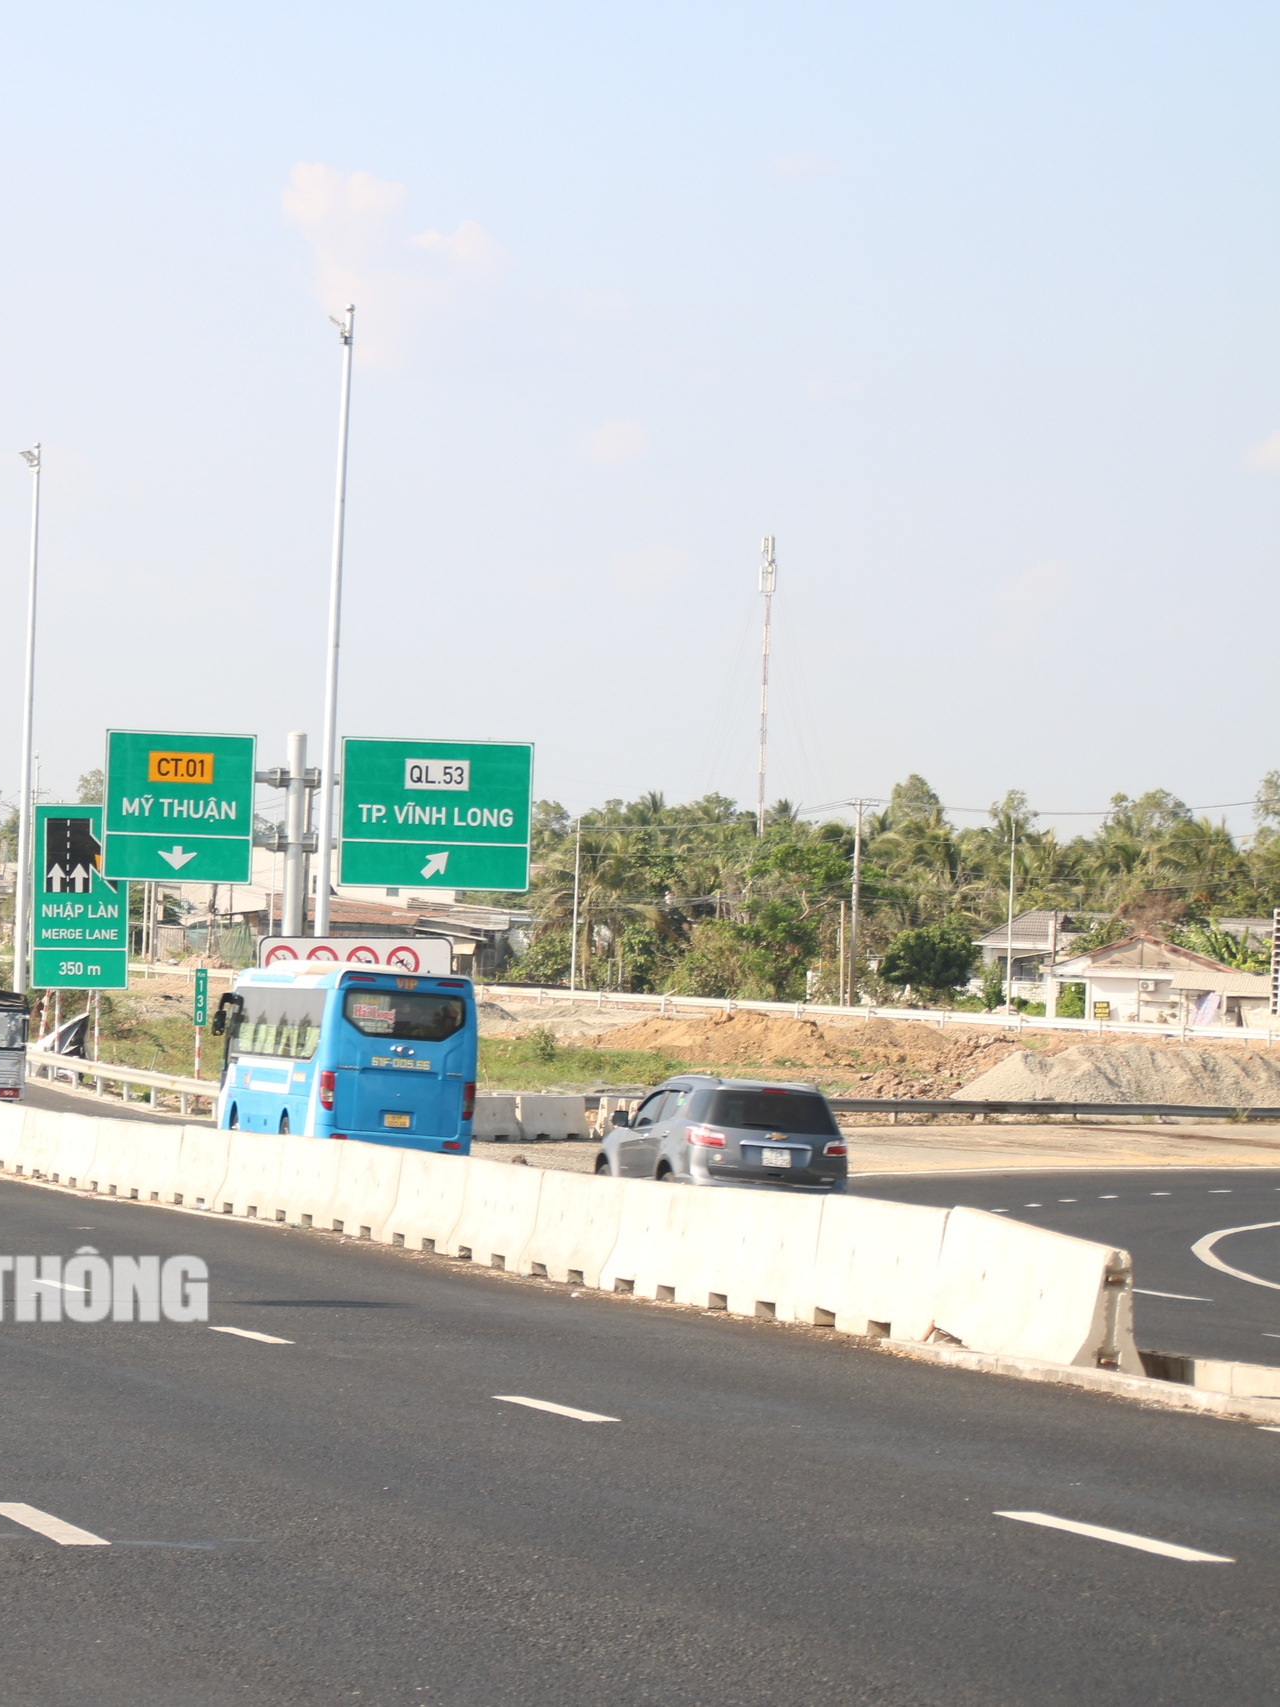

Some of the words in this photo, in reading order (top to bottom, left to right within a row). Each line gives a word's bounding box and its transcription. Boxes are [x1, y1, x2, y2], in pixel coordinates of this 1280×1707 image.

[157, 757, 205, 778] CT.01
[409, 765, 464, 785] QL.53
[122, 794, 154, 817] MỸ
[159, 797, 237, 823] THUẬN
[358, 804, 387, 824] TP.
[393, 802, 446, 826] VĨNH
[453, 807, 514, 827] LONG
[41, 902, 84, 921] NHẬP
[87, 901, 119, 919] LÀN
[41, 928, 83, 940] MERGE
[85, 929, 118, 940] LANE
[58, 962, 83, 976] 350
[87, 964, 101, 976] m
[395, 977, 419, 990] VIP
